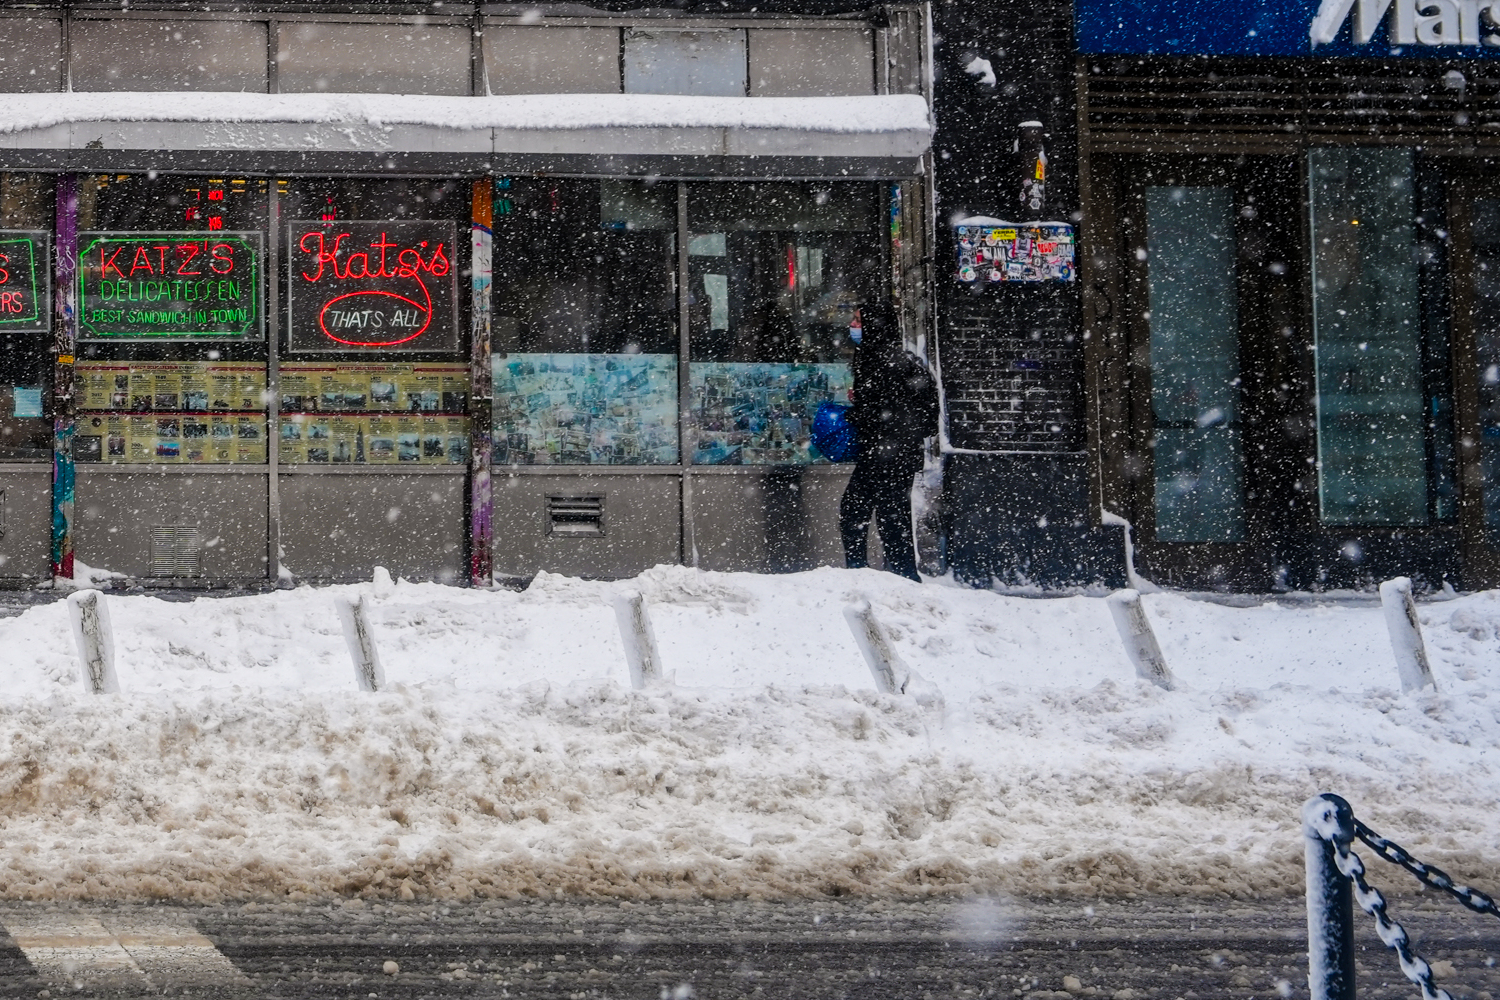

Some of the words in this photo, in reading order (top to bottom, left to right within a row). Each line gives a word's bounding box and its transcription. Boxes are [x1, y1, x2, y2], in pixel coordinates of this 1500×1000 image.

[100, 240, 234, 279] KATZ'S
[300, 232, 449, 282] Katz's
[101, 280, 240, 301] DELICATESSEN
[92, 309, 122, 323] BEST
[127, 310, 192, 324] SANDWICH
[195, 310, 207, 324] IN
[210, 309, 247, 323] TOWN
[391, 310, 420, 327] ALL
